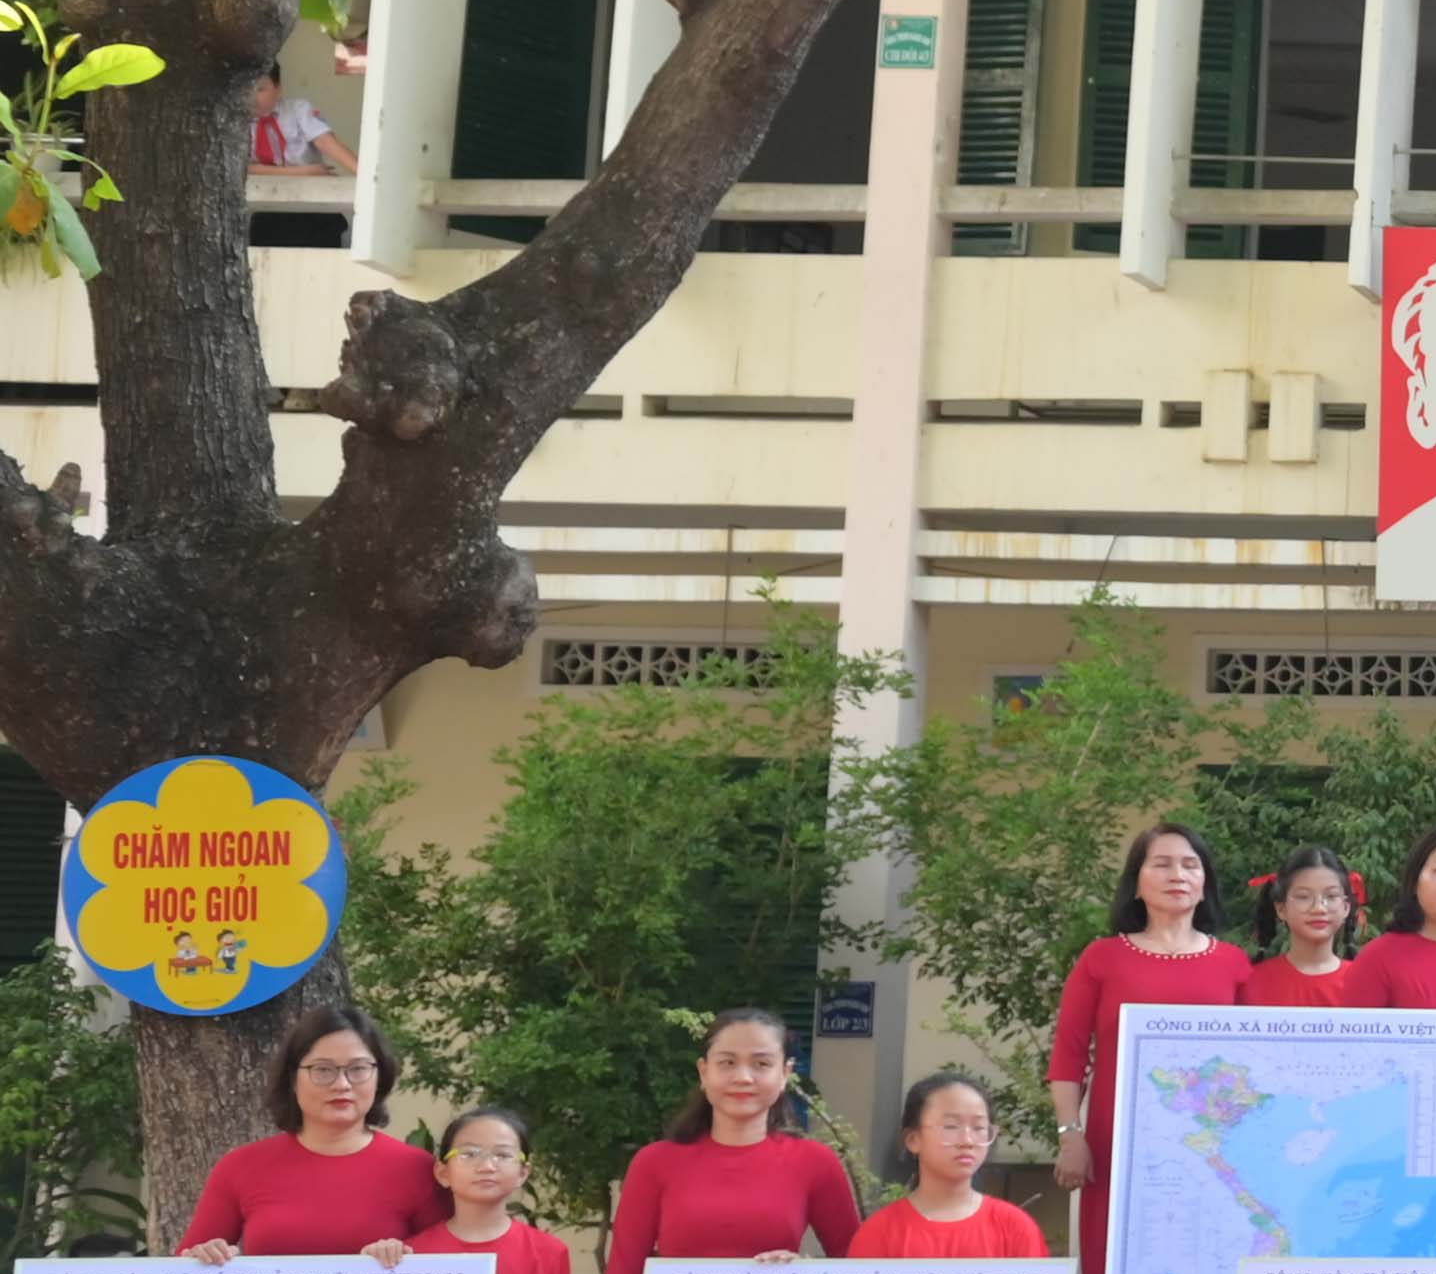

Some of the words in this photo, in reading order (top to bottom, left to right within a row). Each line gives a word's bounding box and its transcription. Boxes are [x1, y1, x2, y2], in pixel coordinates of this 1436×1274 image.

[113, 824, 191, 869] CHĂM
[200, 831, 292, 867] NGOAN
[144, 886, 196, 932] HỌC
[206, 874, 259, 922] GIỎI
